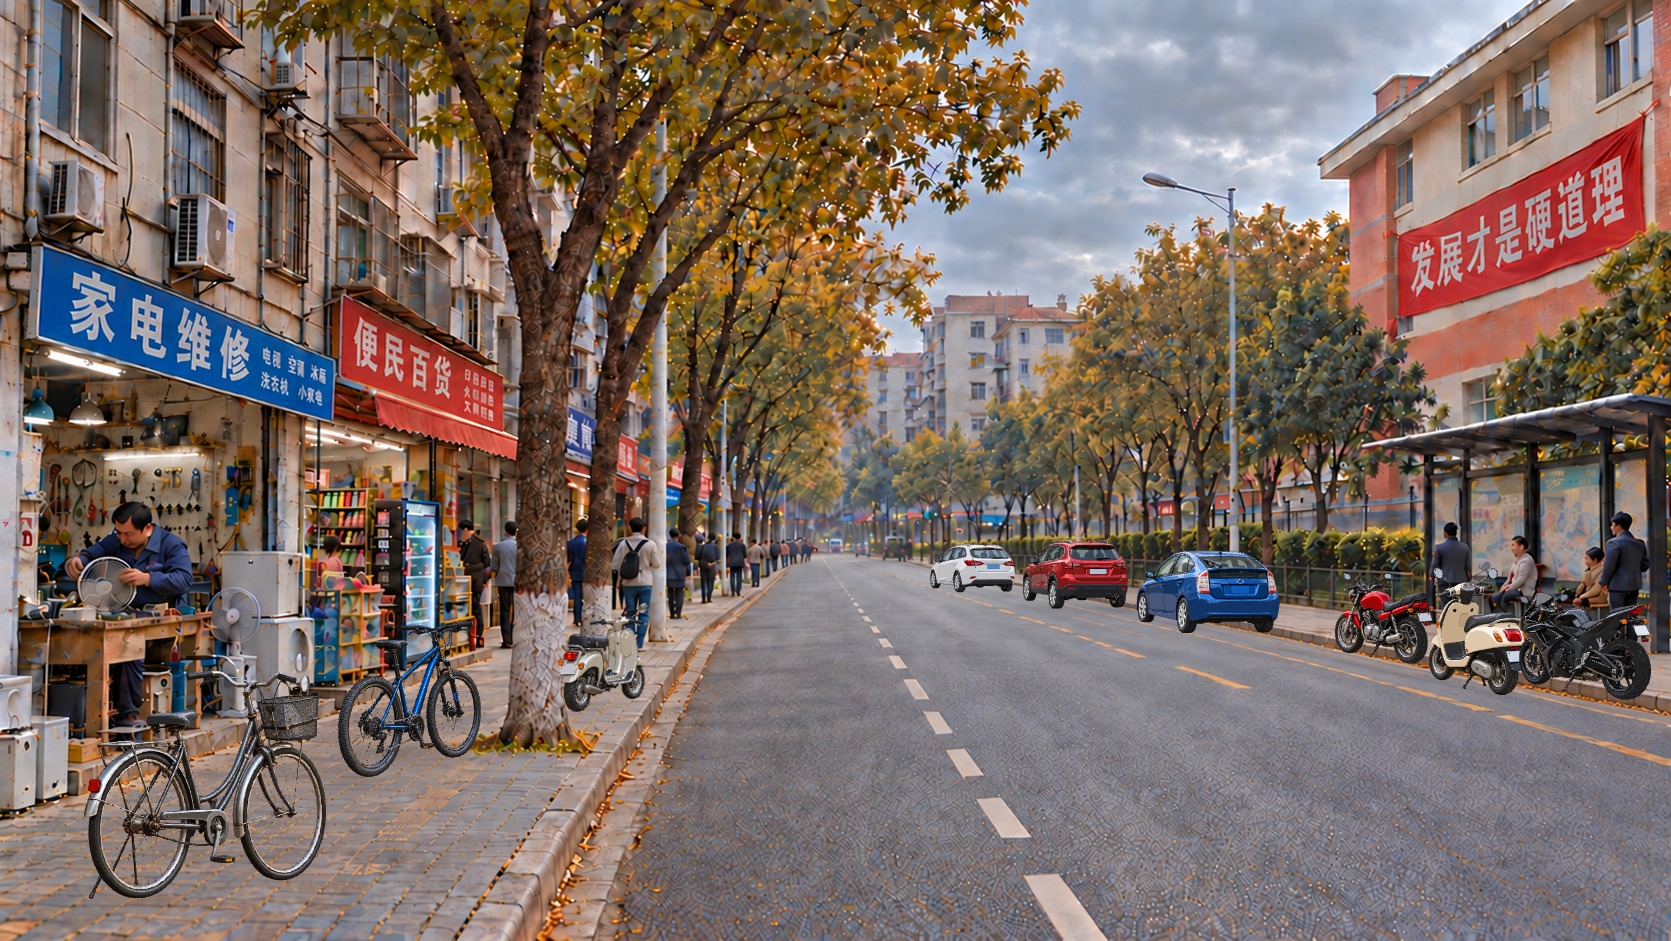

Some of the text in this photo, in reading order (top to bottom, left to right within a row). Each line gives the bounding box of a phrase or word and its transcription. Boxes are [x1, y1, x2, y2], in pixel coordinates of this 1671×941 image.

[1410, 155, 1626, 297] 发展才是硬道理
[70, 270, 251, 382] 家电维修
[353, 316, 452, 399] 便民百货
